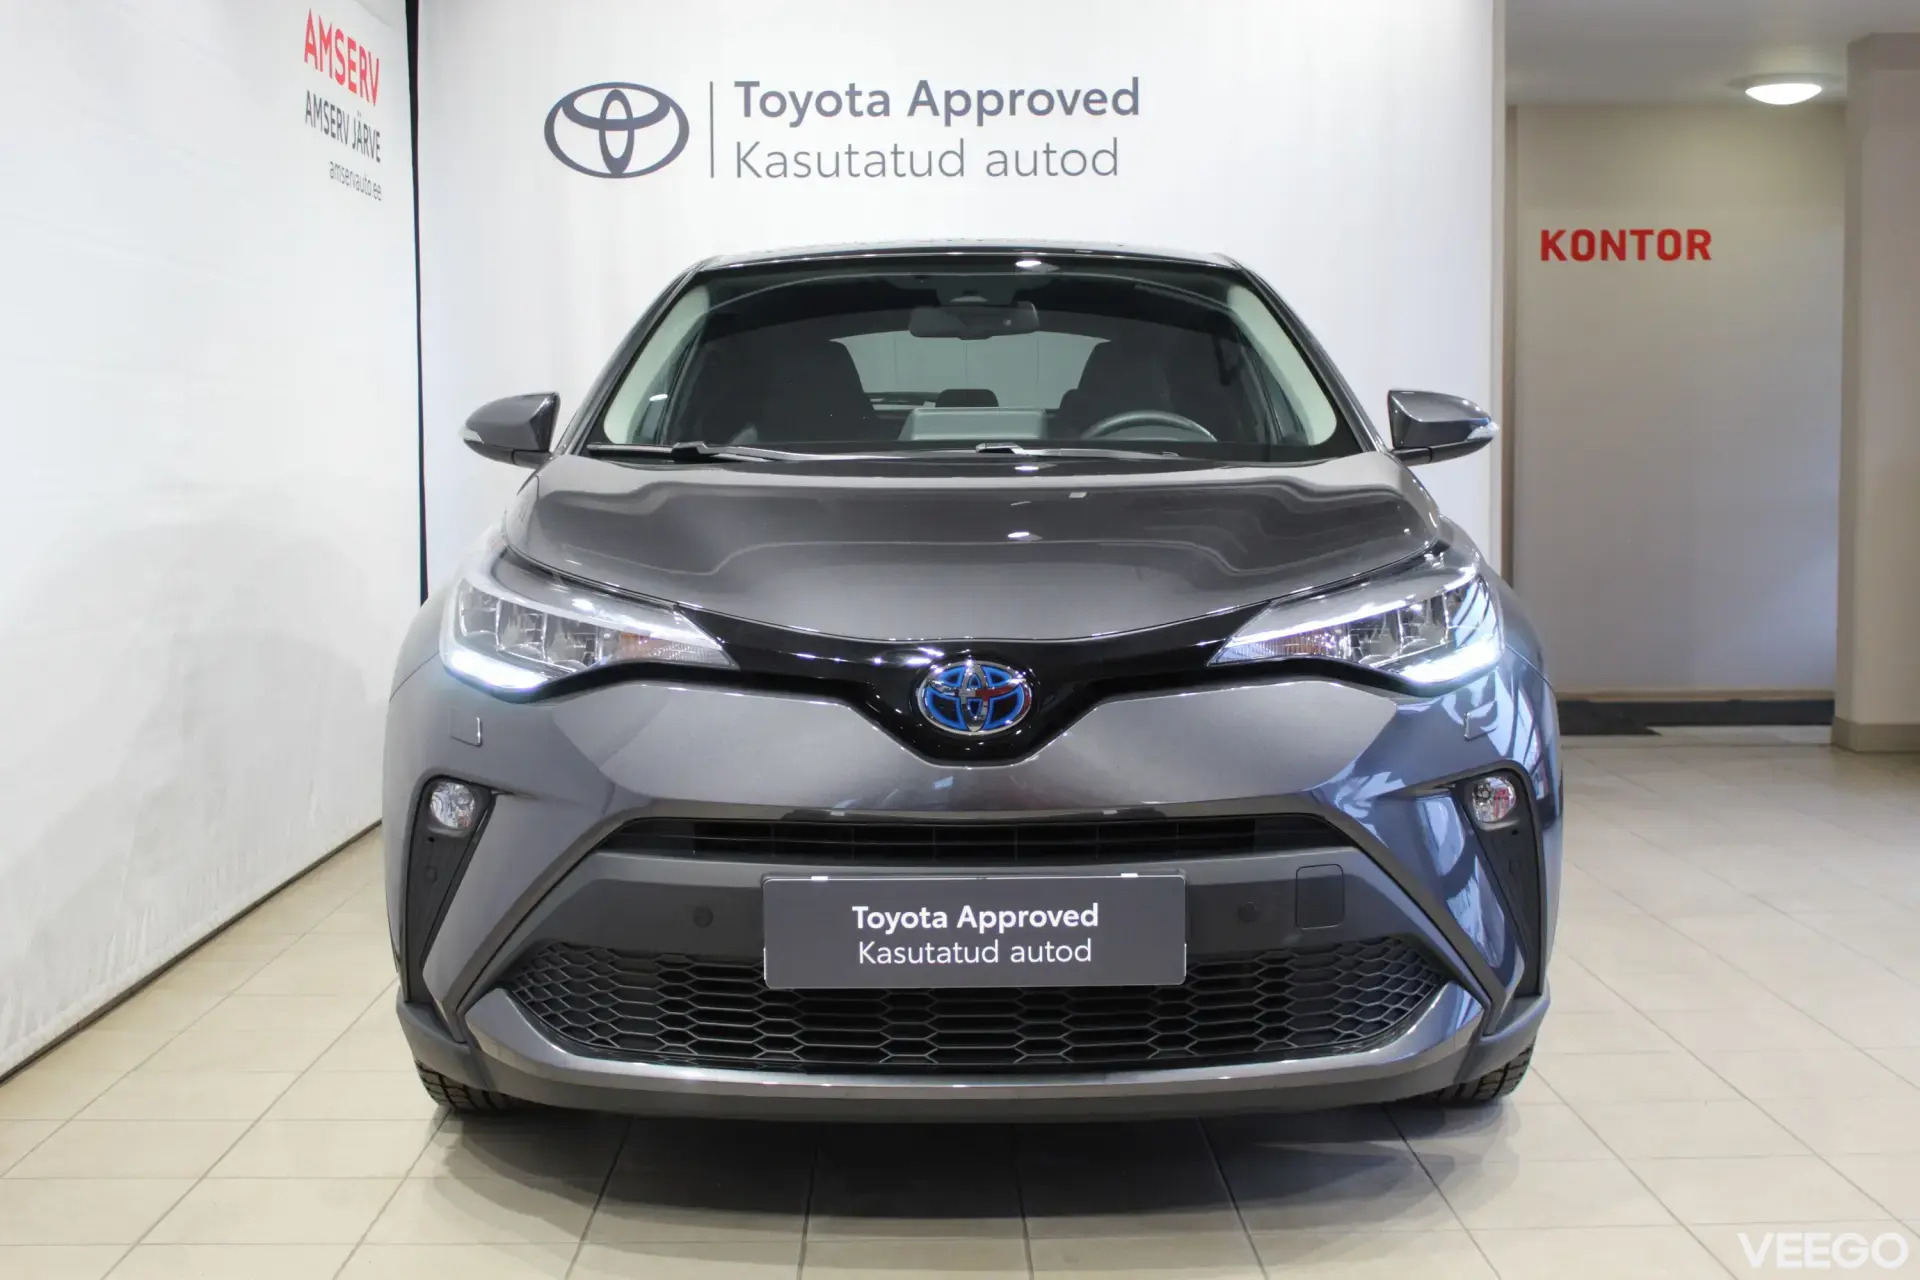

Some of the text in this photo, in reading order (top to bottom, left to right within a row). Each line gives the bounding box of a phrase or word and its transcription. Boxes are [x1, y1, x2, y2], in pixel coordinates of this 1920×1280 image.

[304, 8, 379, 106] AMSERV
[734, 77, 1140, 127] Toyota Approved
[305, 90, 381, 163] AMSERV JÄRVE
[735, 137, 1118, 178] Kasutatud autod
[329, 161, 382, 201] amservauto.ee
[1540, 229, 1712, 261] KONTOR
[852, 902, 1099, 934] Toyota Approved
[858, 938, 1092, 964] Kasutatud autod
